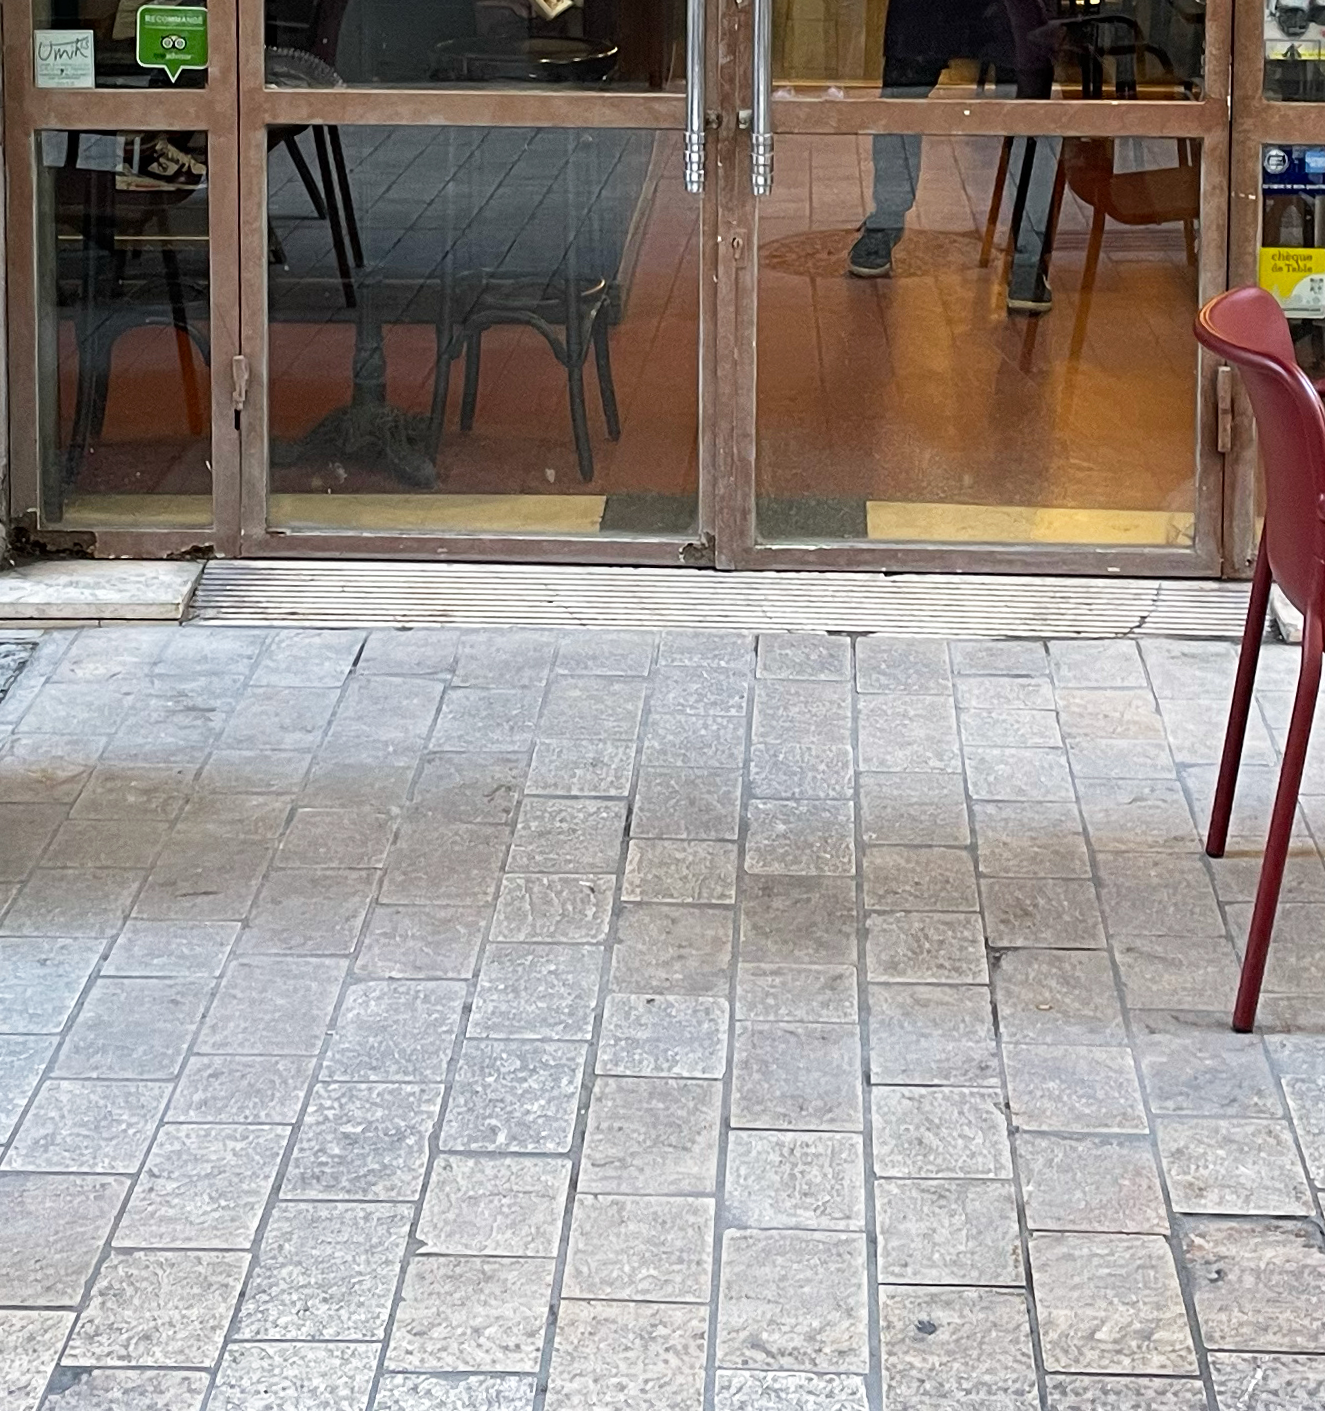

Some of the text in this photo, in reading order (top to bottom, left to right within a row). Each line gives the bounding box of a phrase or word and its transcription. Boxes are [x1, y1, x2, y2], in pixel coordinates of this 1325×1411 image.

[1271, 251, 1313, 269] chèque
[1271, 262, 1313, 273] de Table
